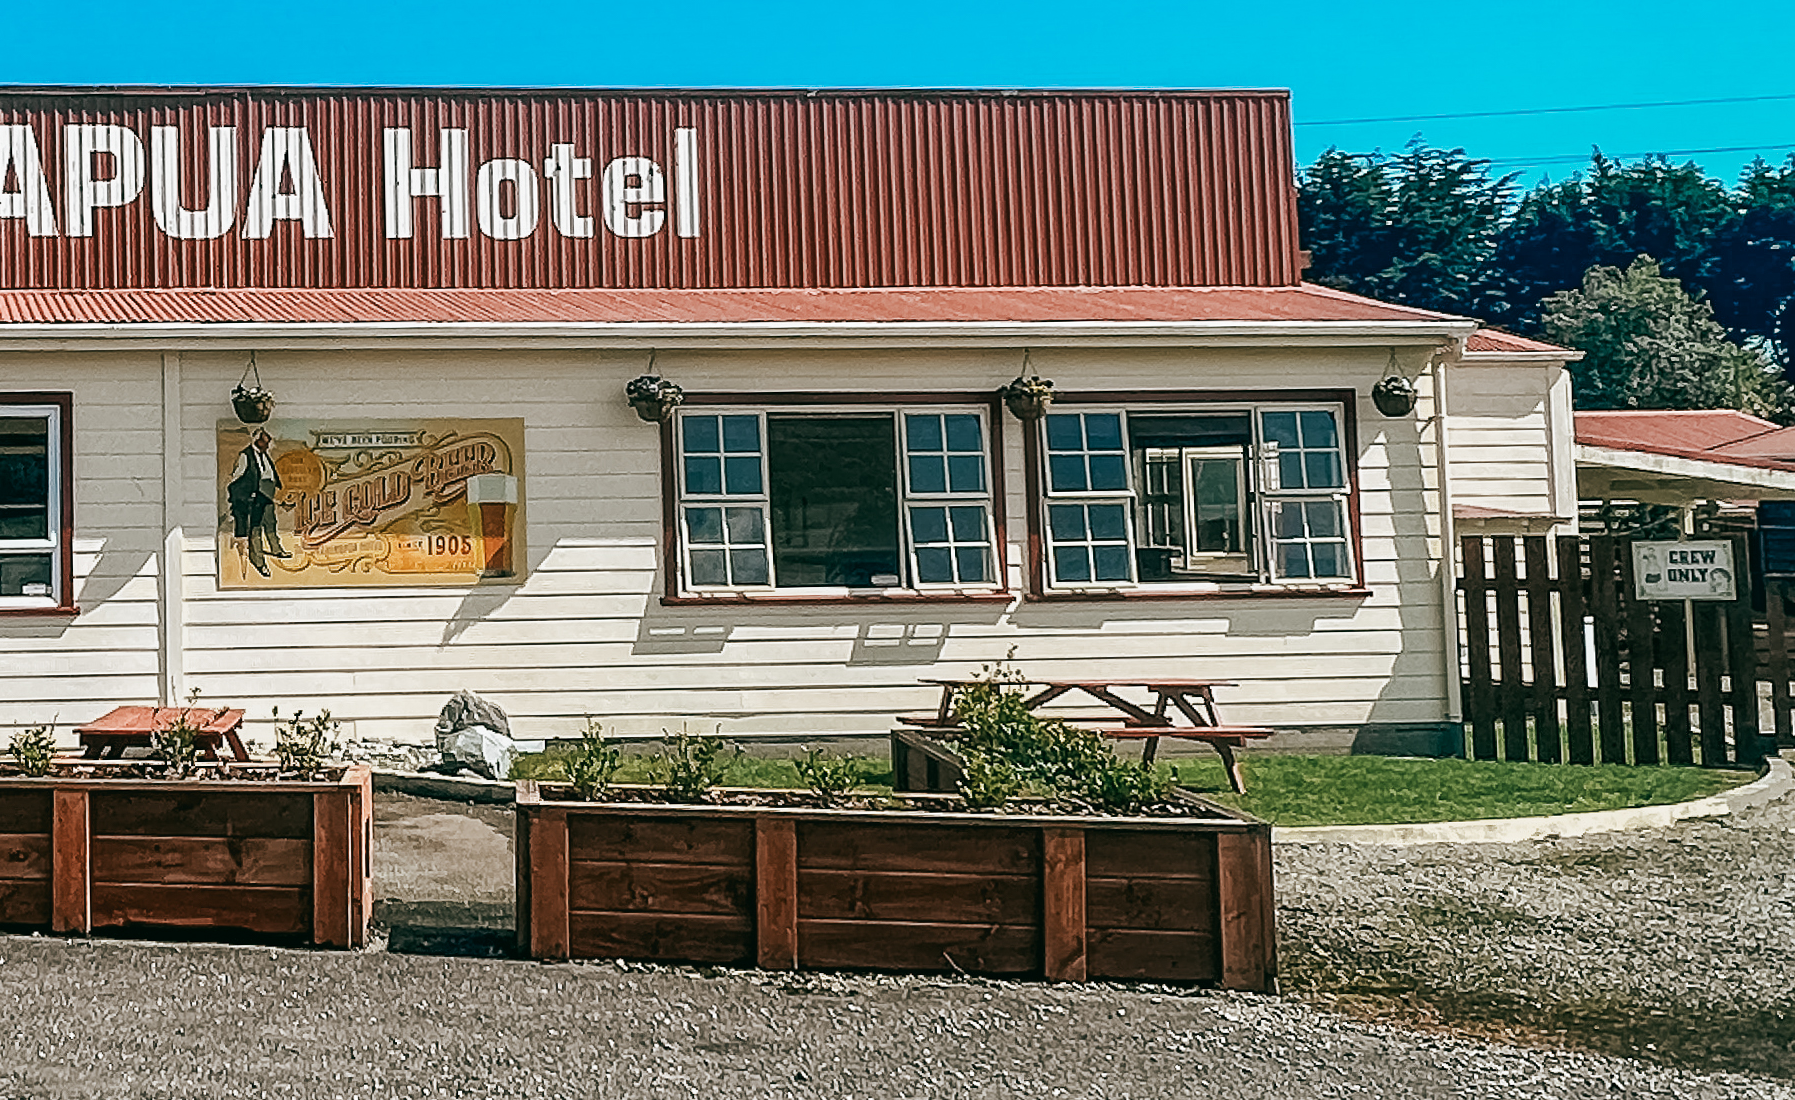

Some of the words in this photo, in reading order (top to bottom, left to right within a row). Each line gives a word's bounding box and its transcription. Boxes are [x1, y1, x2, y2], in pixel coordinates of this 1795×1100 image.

[384, 127, 700, 240] Hotel
[427, 535, 472, 556] 1905
[1668, 550, 1716, 565] CREW
[1667, 568, 1709, 583] ONLY
